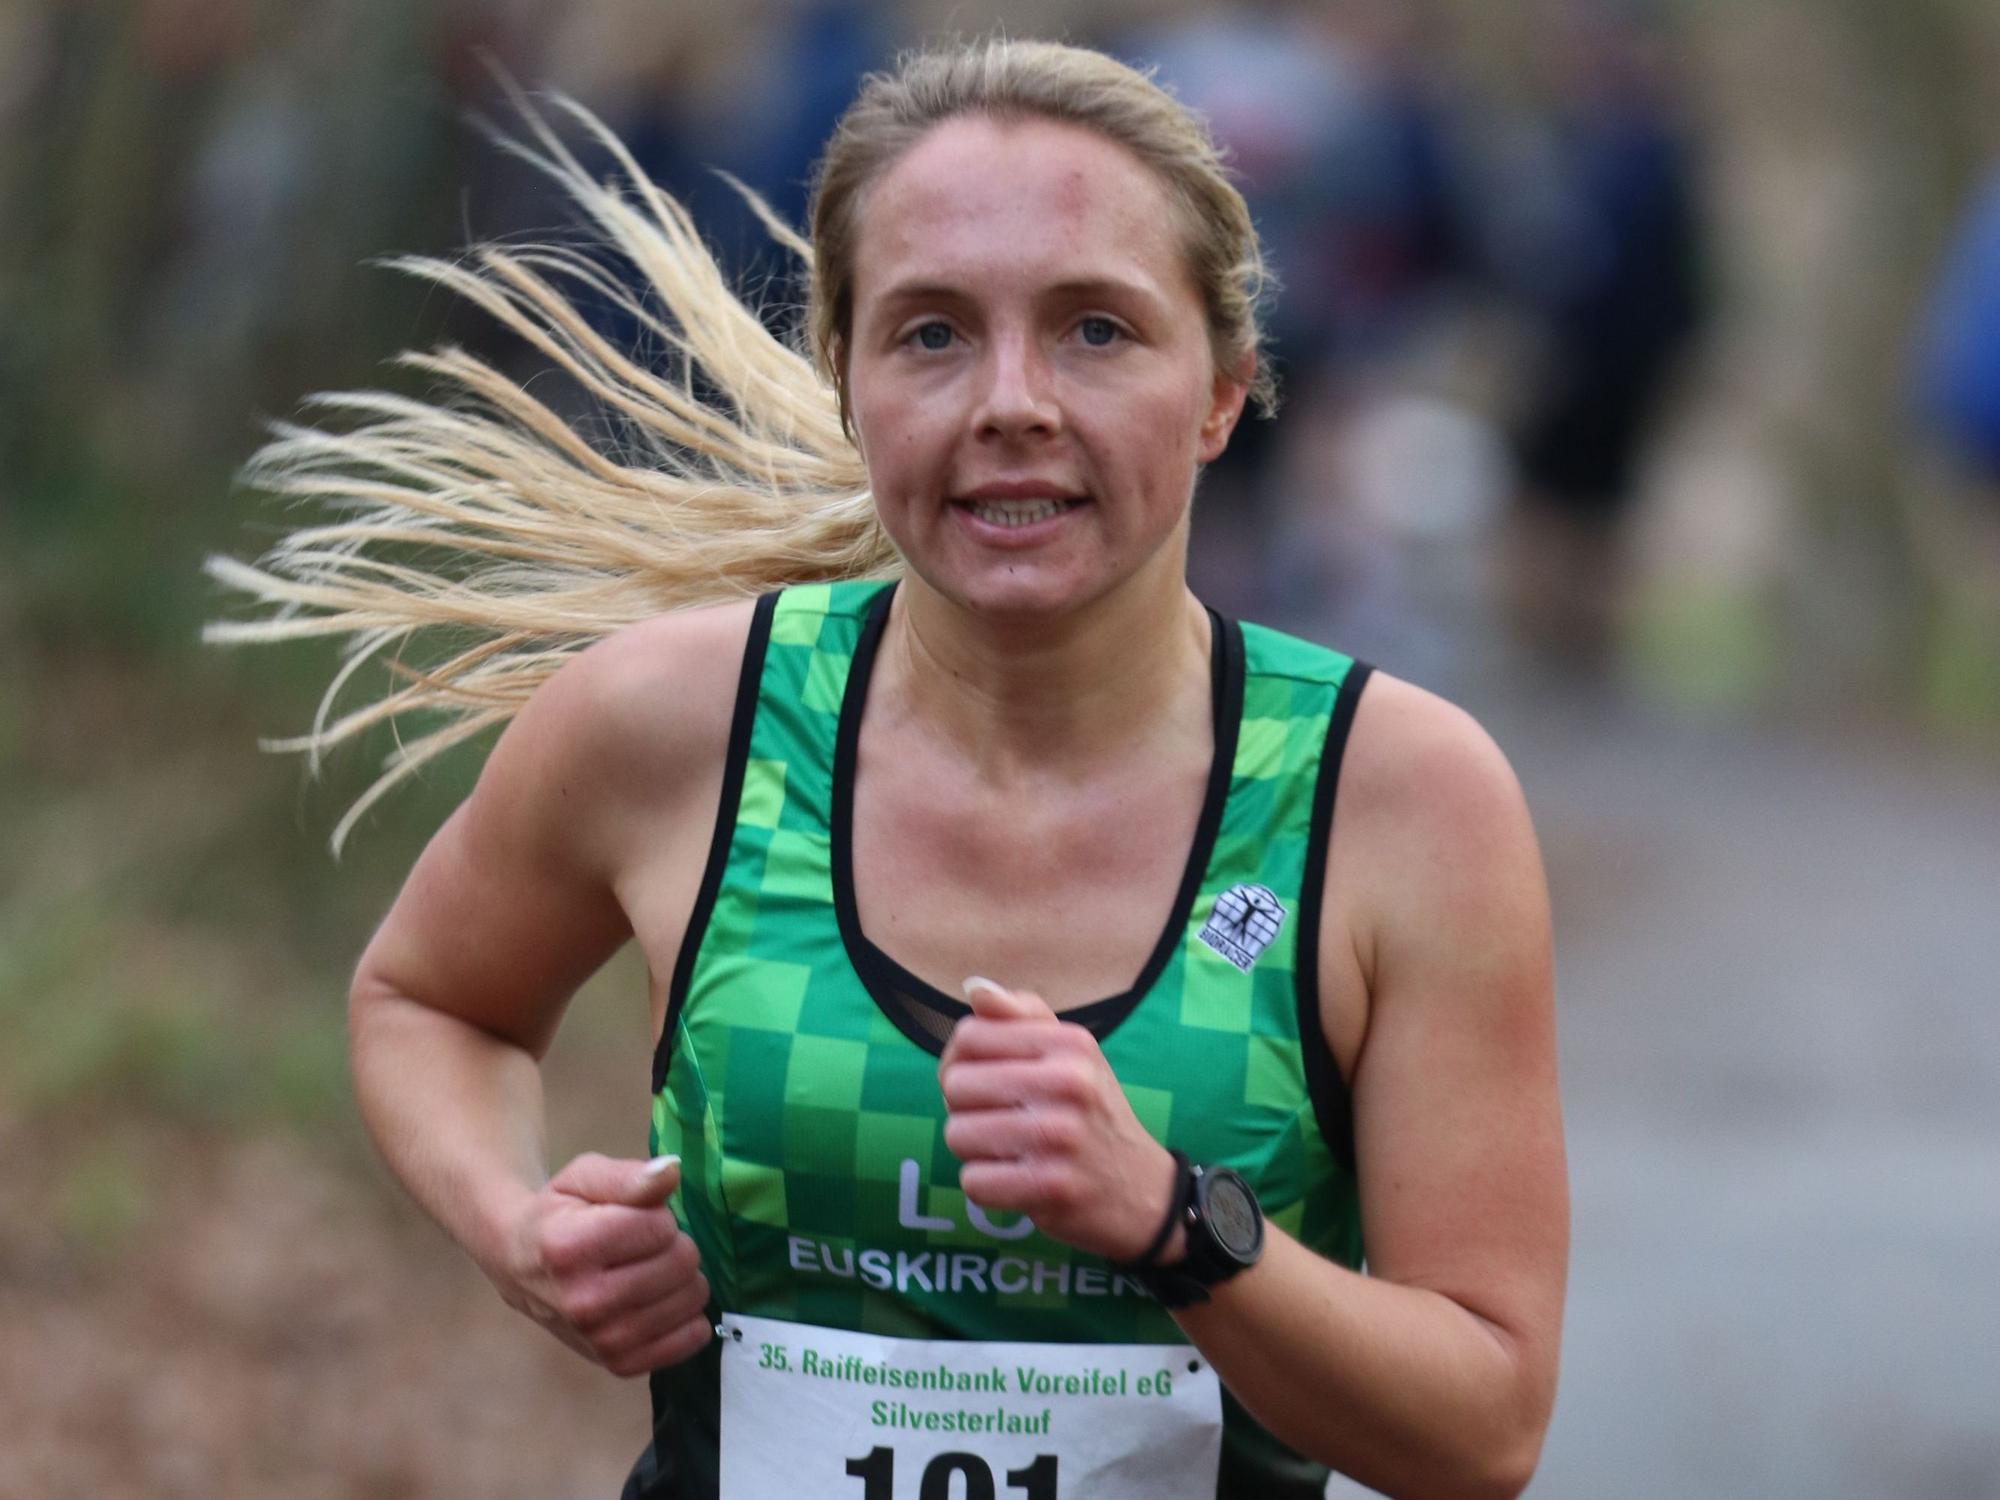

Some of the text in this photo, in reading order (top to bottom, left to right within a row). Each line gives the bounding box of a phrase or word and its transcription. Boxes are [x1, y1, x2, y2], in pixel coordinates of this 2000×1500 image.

[759, 1343, 1172, 1397] 35. Raiffeisenbank Voreifel eG
[871, 1400, 1051, 1435] Silvesterlauf
